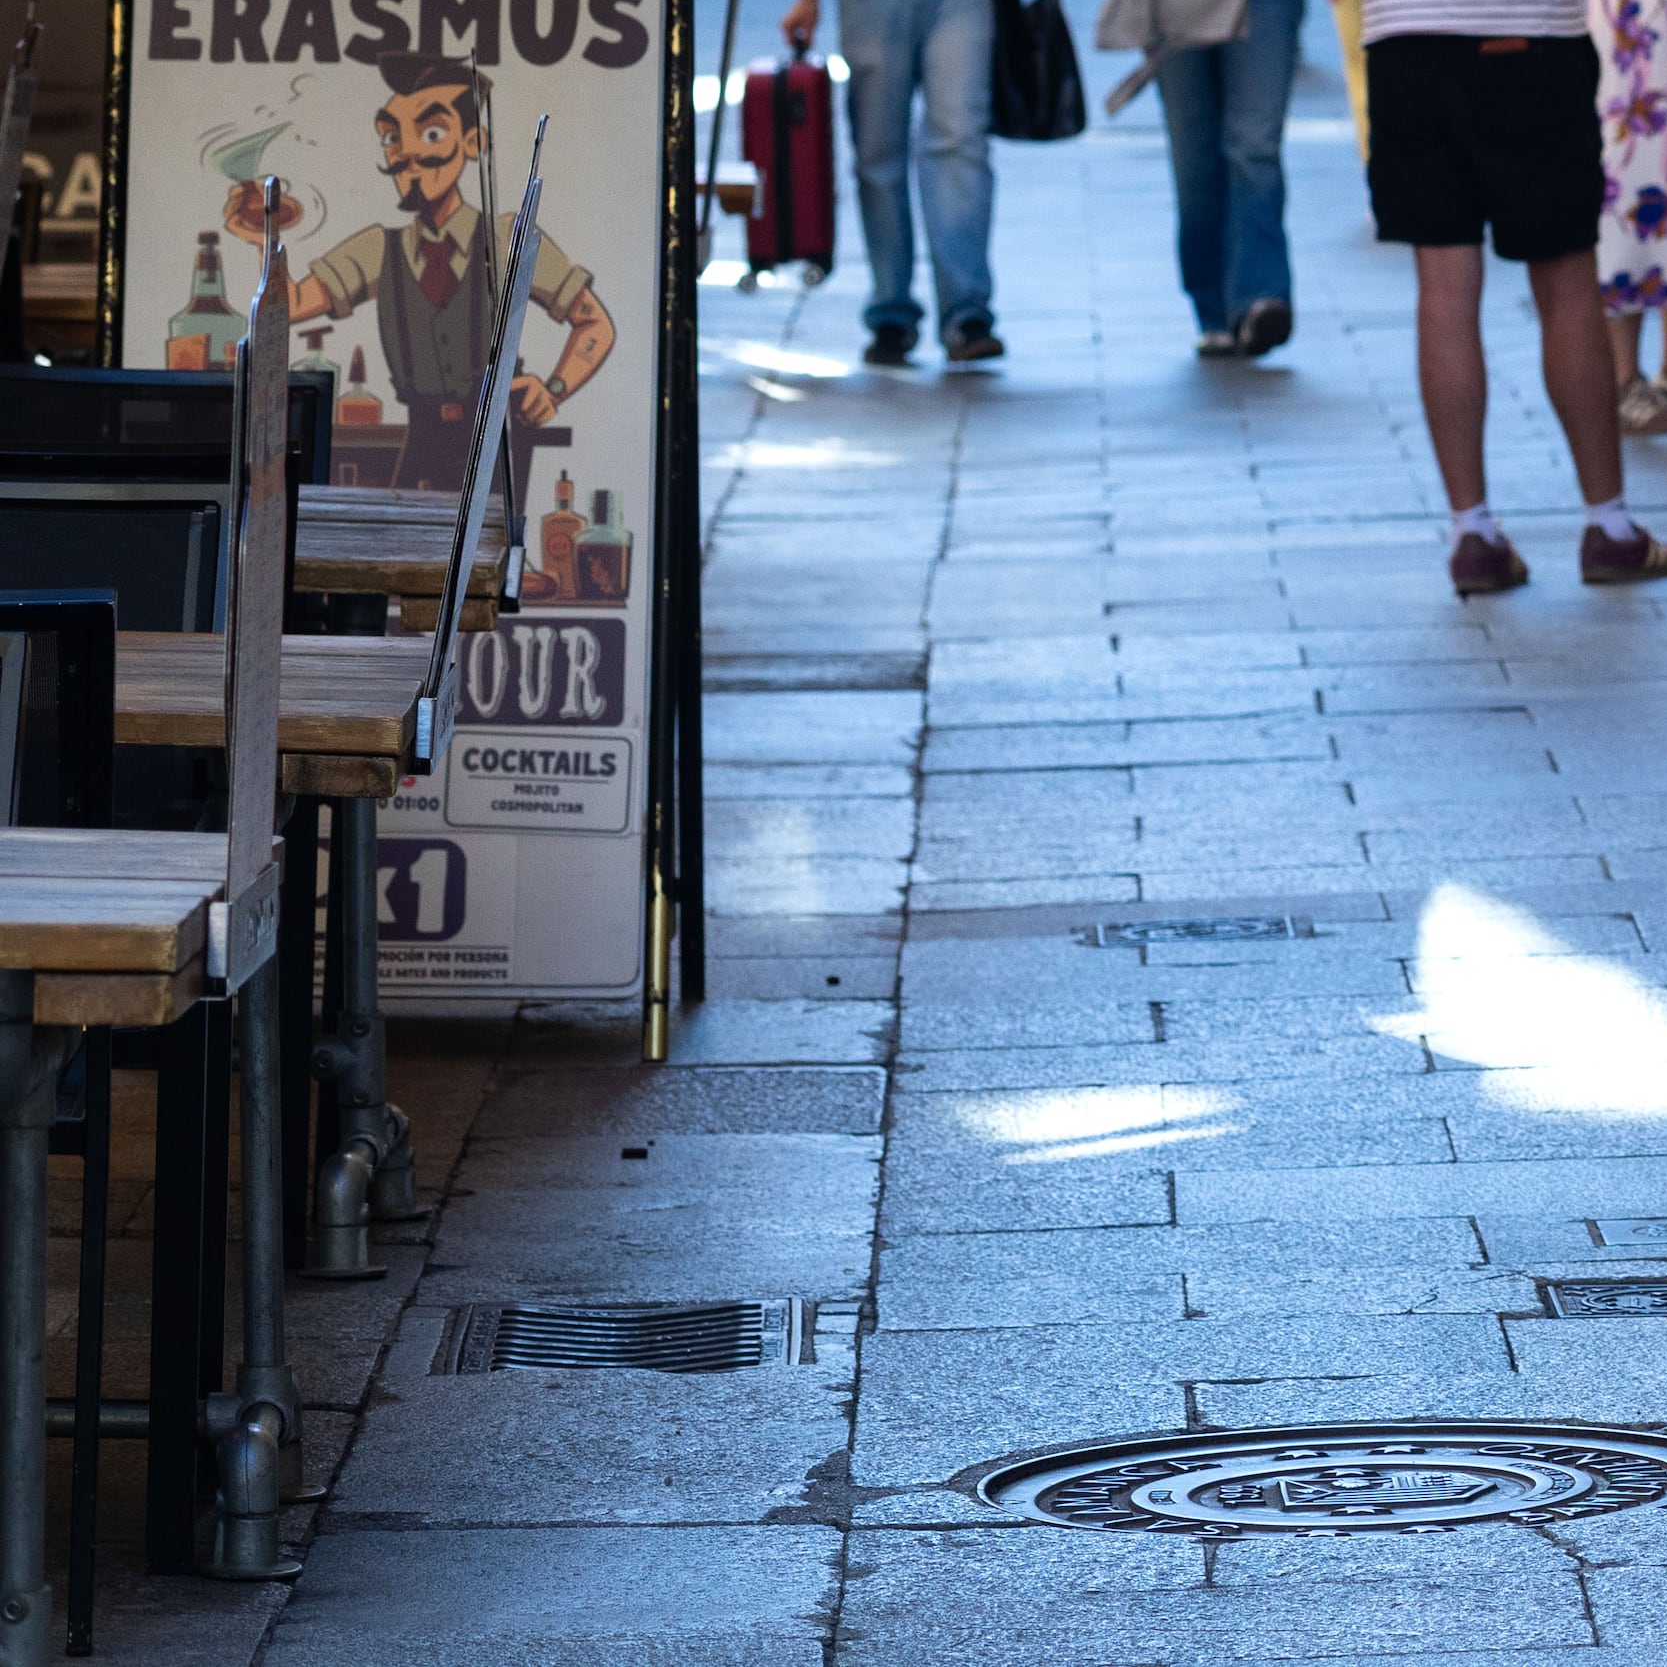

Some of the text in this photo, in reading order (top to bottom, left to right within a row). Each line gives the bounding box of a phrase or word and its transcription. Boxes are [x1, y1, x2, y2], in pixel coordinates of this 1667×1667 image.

[453, 626, 607, 720] OUR
[462, 747, 617, 777] COCKTAILS
[514, 784, 559, 796] MOJITO
[1051, 1460, 1242, 1536] SALAMANCA
